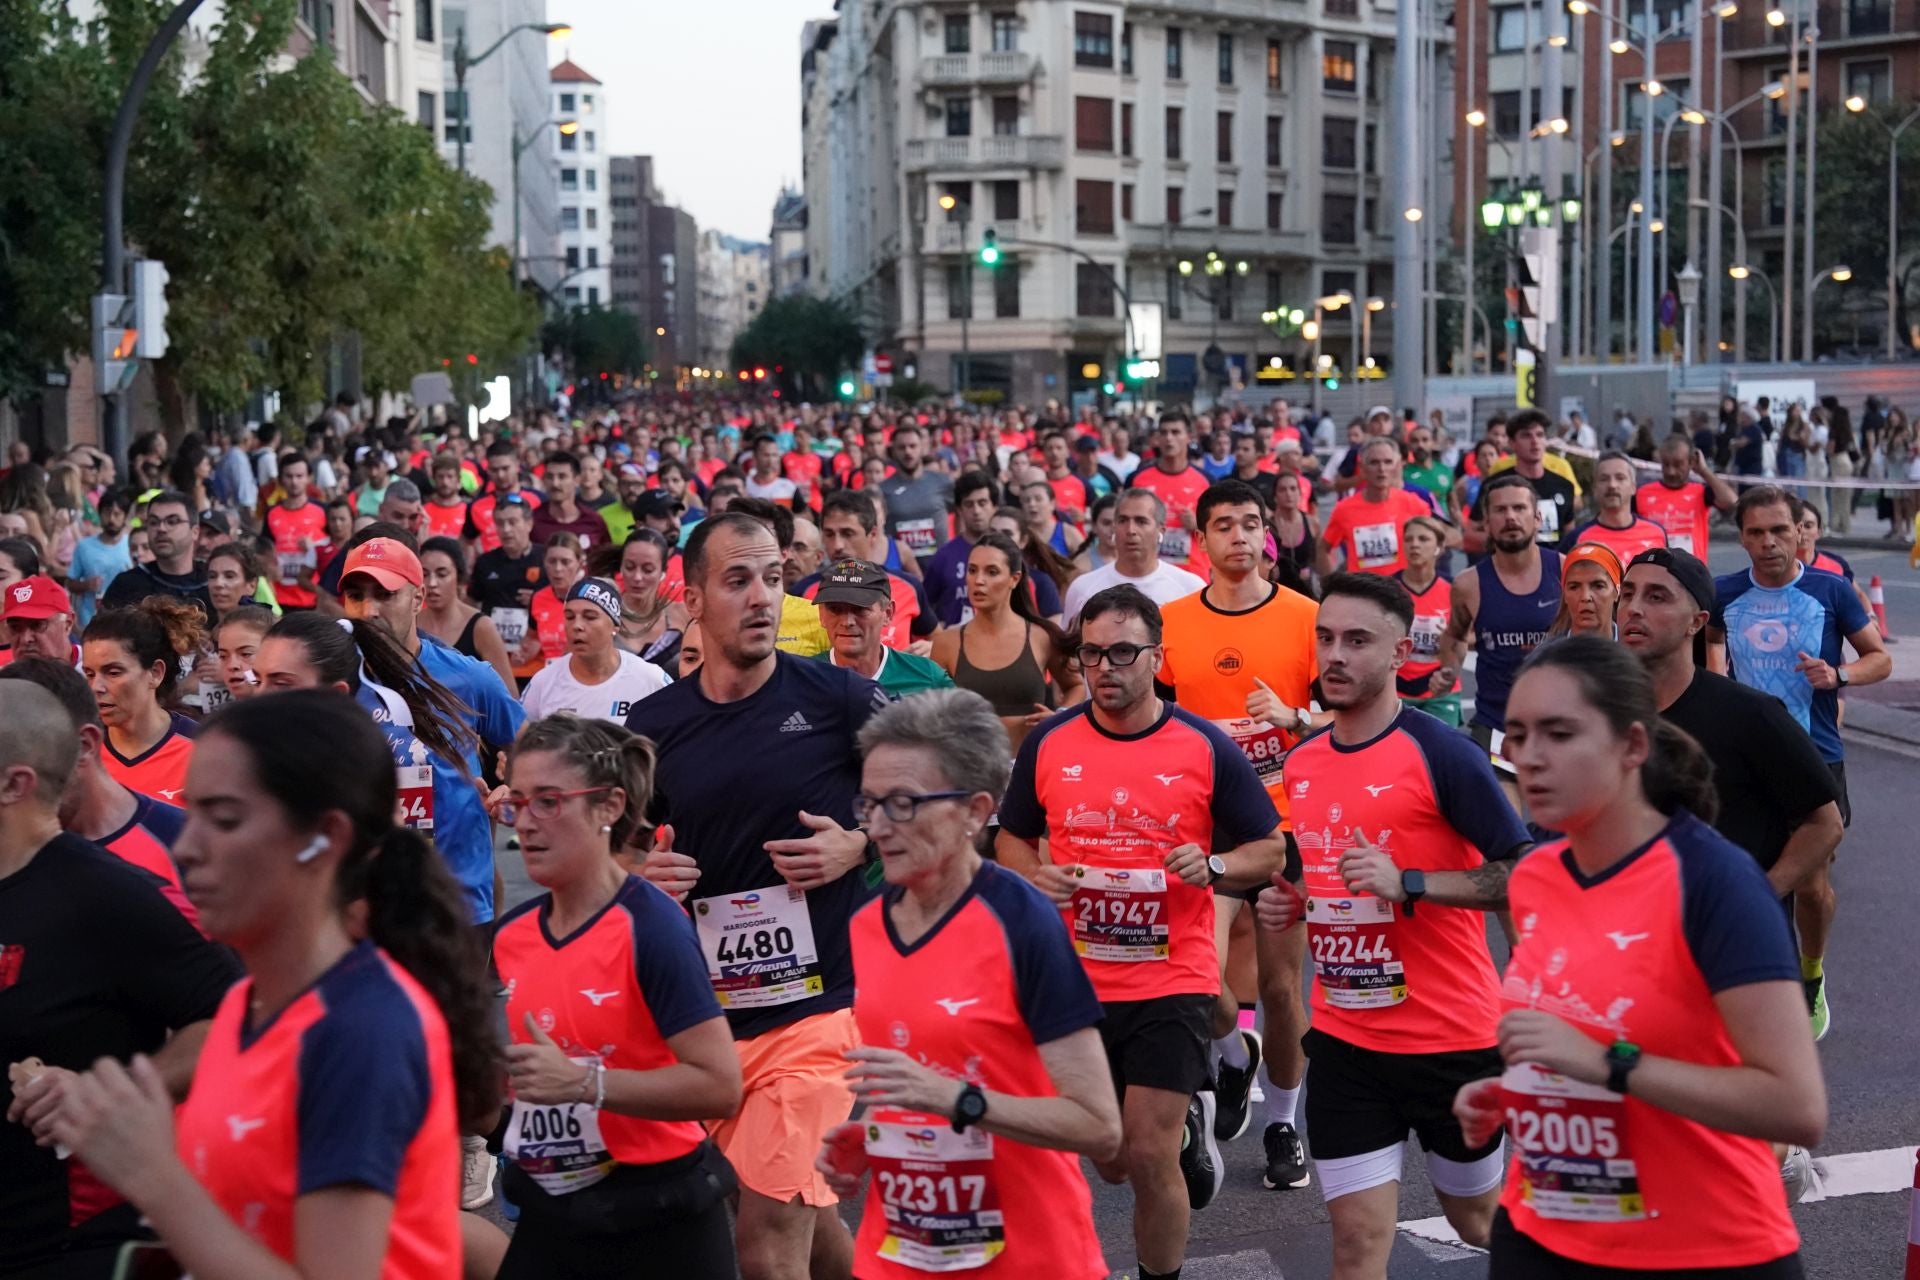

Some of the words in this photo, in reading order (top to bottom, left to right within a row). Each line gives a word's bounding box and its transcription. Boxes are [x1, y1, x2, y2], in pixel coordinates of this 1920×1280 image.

[1496, 632, 1524, 646] LECH
[780, 724, 813, 732] adidas
[723, 917, 778, 931] MARIOGOMEZ
[1079, 897, 1161, 925] 21947
[717, 926, 794, 963] 4480
[1312, 934, 1393, 963] 22244
[521, 1105, 581, 1142] 4006
[879, 1170, 986, 1212] 22317
